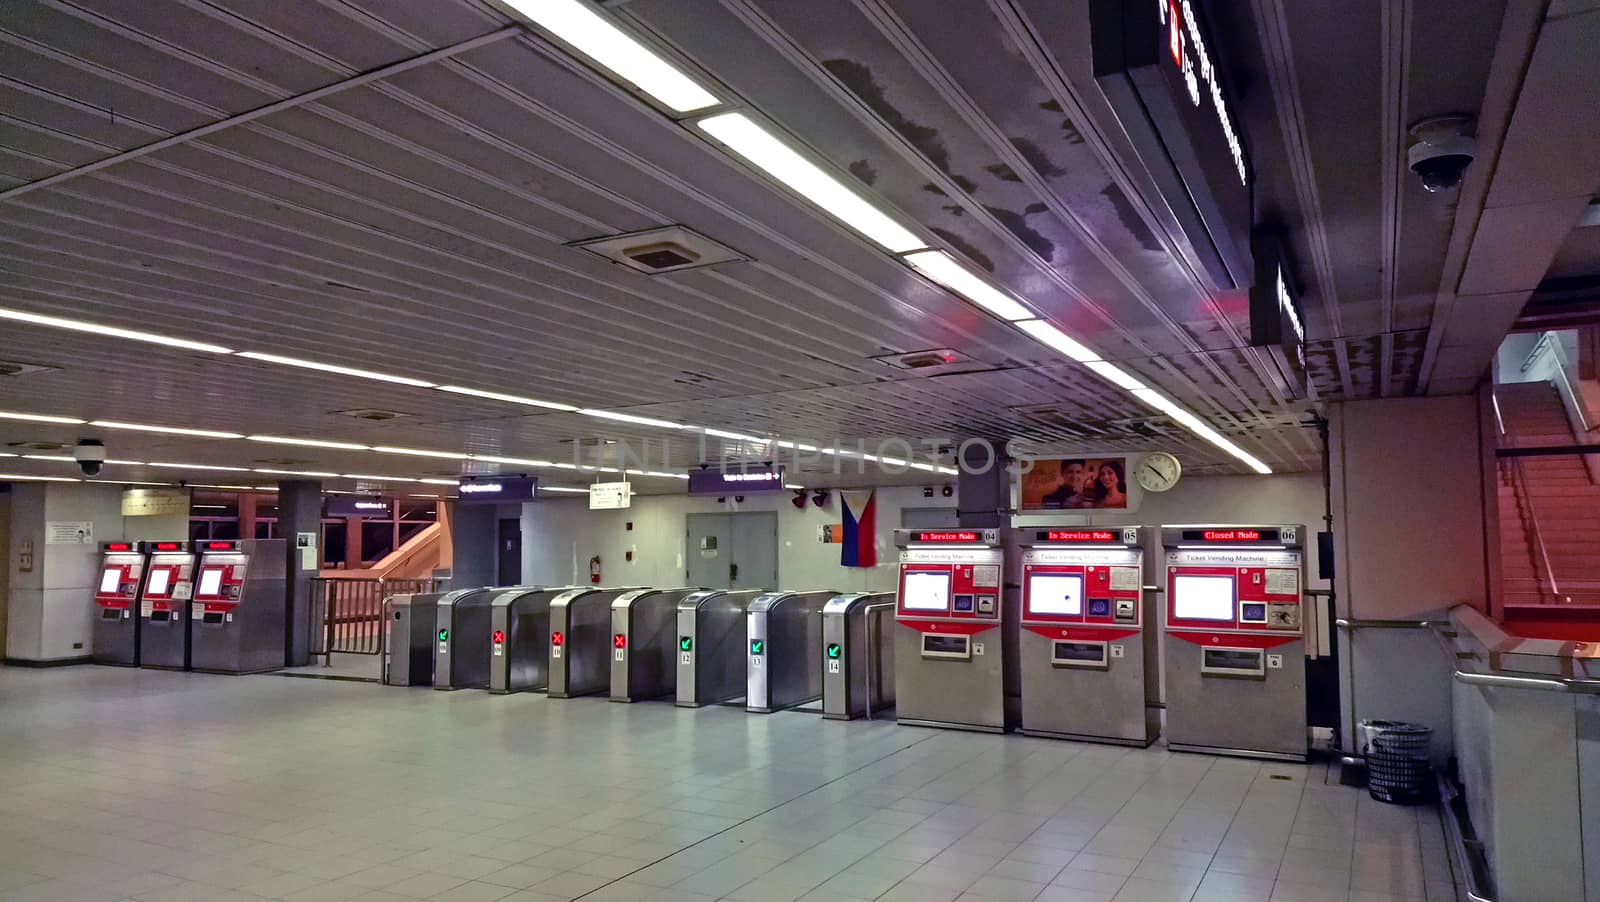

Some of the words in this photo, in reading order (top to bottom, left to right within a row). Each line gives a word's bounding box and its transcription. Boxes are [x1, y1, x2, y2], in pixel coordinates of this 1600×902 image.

[1178, 0, 1210, 84] assenger
[930, 533, 957, 541] Service
[959, 533, 977, 541] Mode
[985, 533, 996, 541] 04
[1048, 532, 1059, 540] In
[1060, 532, 1091, 540] Service
[1093, 532, 1112, 540] Mode
[1124, 532, 1136, 541] 05
[1205, 531, 1234, 539] Closed
[1238, 531, 1259, 539] Mode
[1281, 530, 1295, 540] 06
[1207, 555, 1234, 563] Vending
[830, 662, 838, 671] 14
